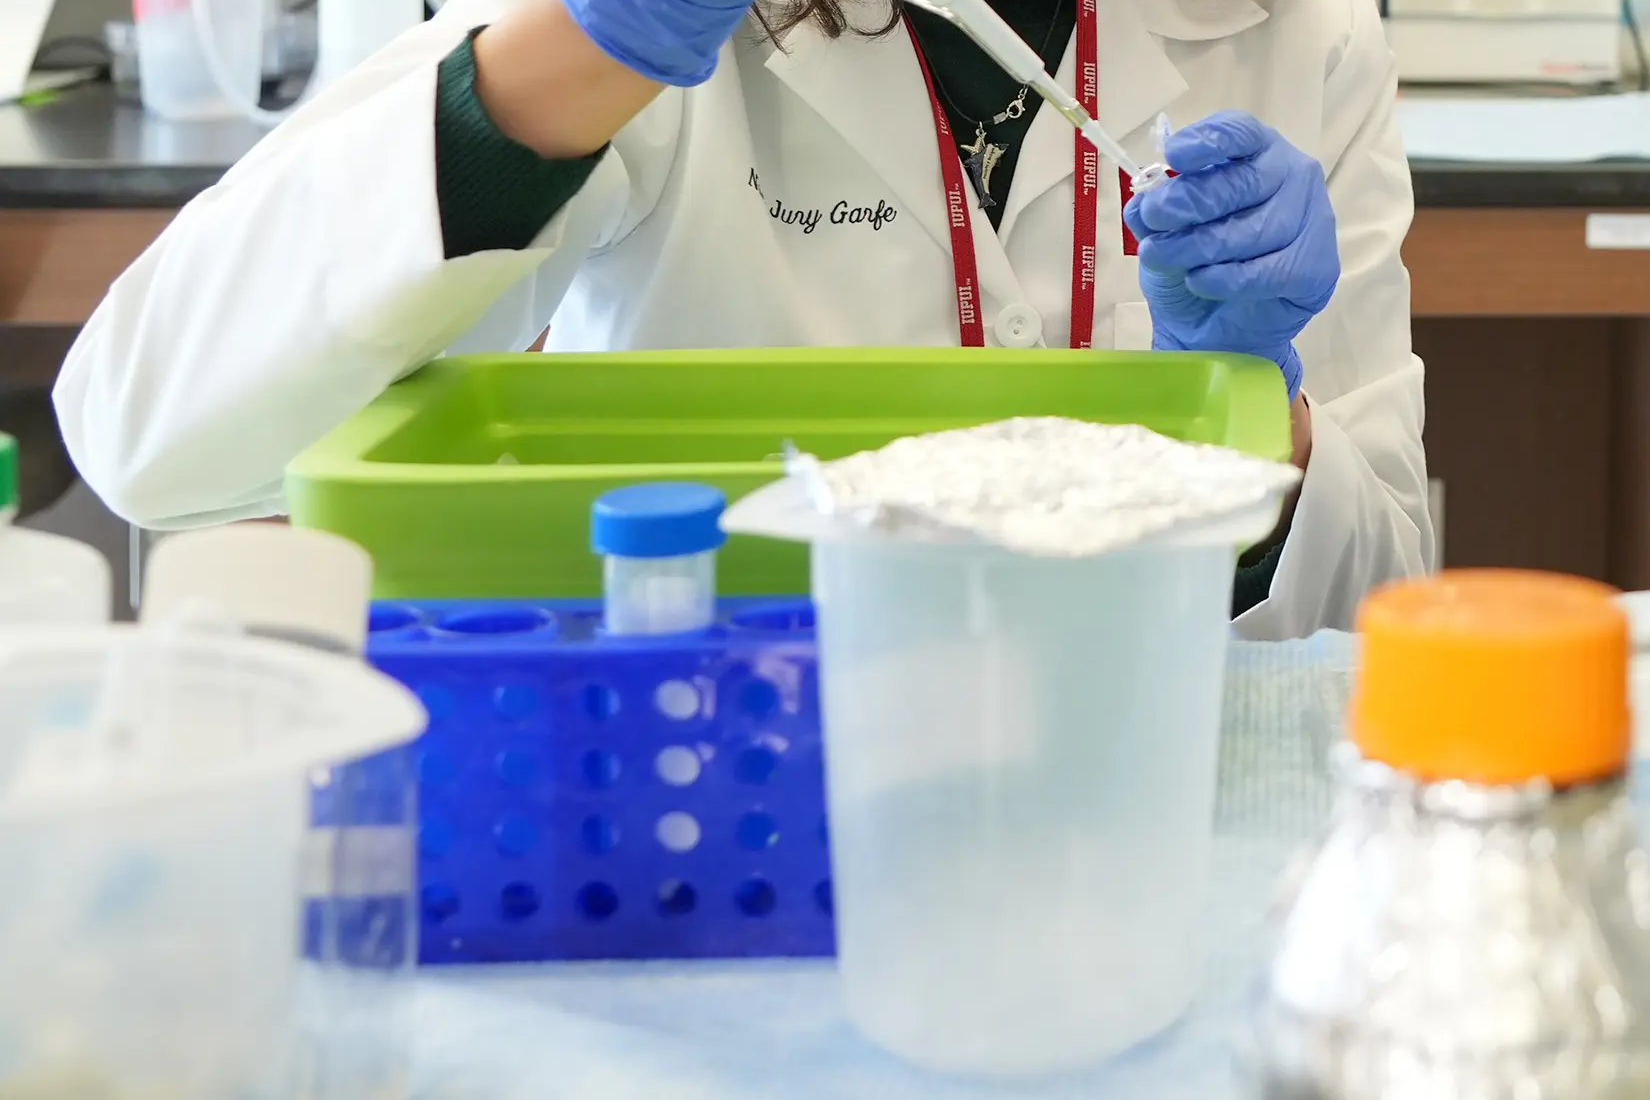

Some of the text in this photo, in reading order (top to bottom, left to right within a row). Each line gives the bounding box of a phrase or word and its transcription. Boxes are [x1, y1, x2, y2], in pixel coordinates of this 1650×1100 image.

[1083, 62, 1096, 97] IUPUI
[1083, 152, 1097, 189] IUPUI
[948, 190, 966, 228] IUPUI
[1082, 245, 1095, 283] IUPUI
[958, 286, 975, 324] IUPUI
